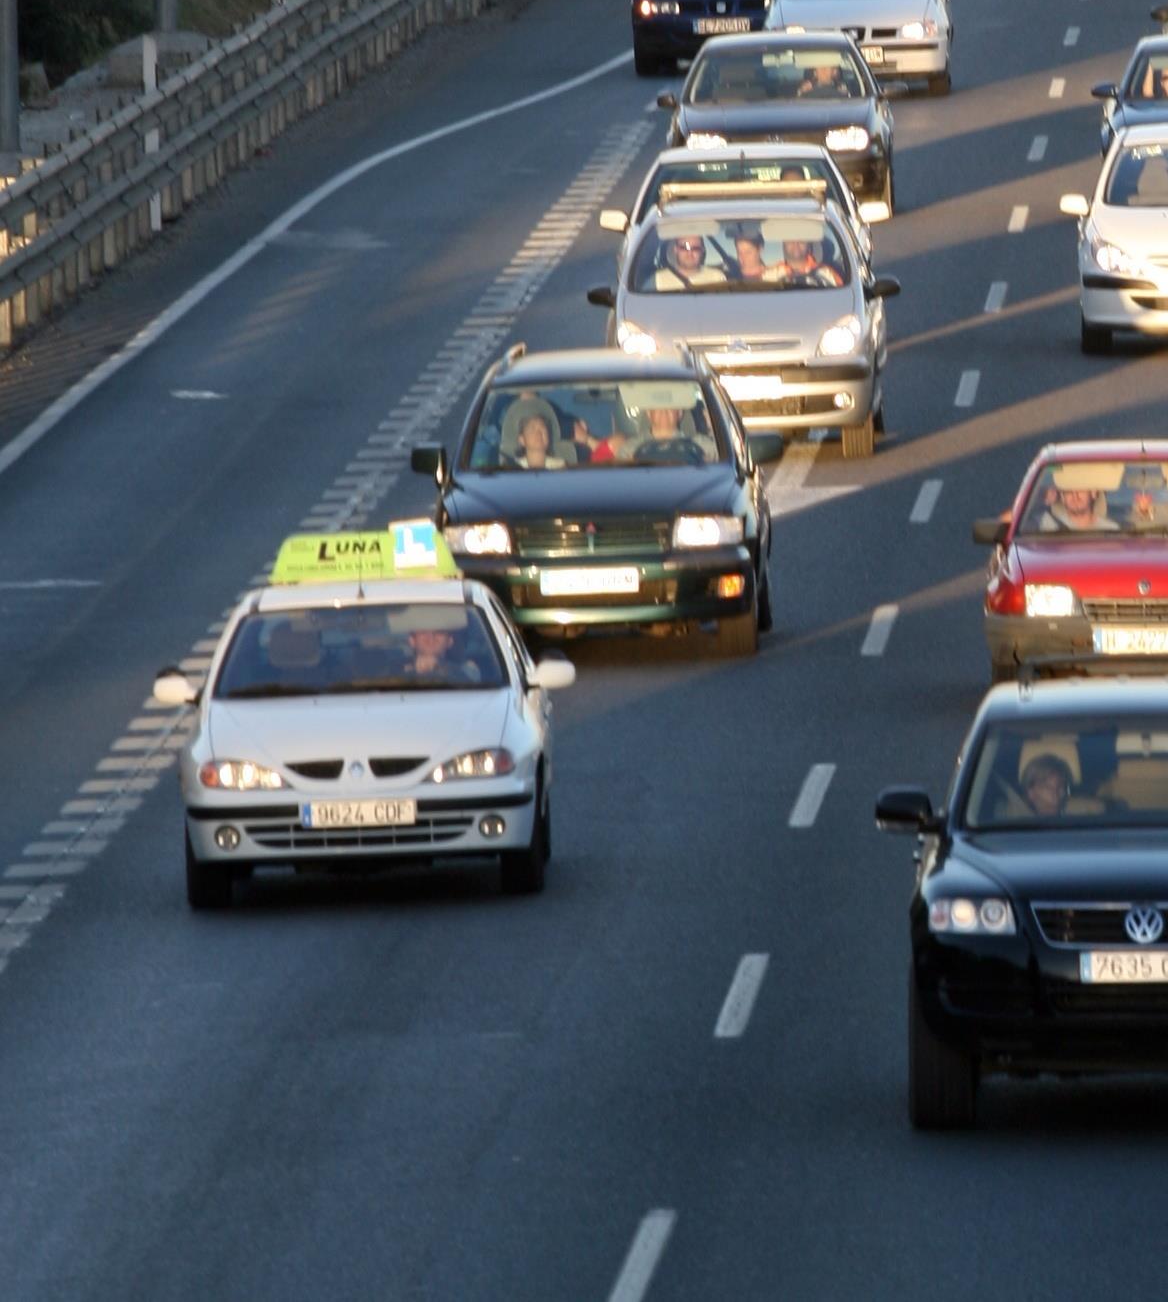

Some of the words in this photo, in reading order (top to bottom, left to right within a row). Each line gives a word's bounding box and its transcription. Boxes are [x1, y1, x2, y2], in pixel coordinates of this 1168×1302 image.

[317, 541, 382, 562] LUNA
[318, 802, 364, 825] 9624
[1096, 953, 1151, 978] 7635
